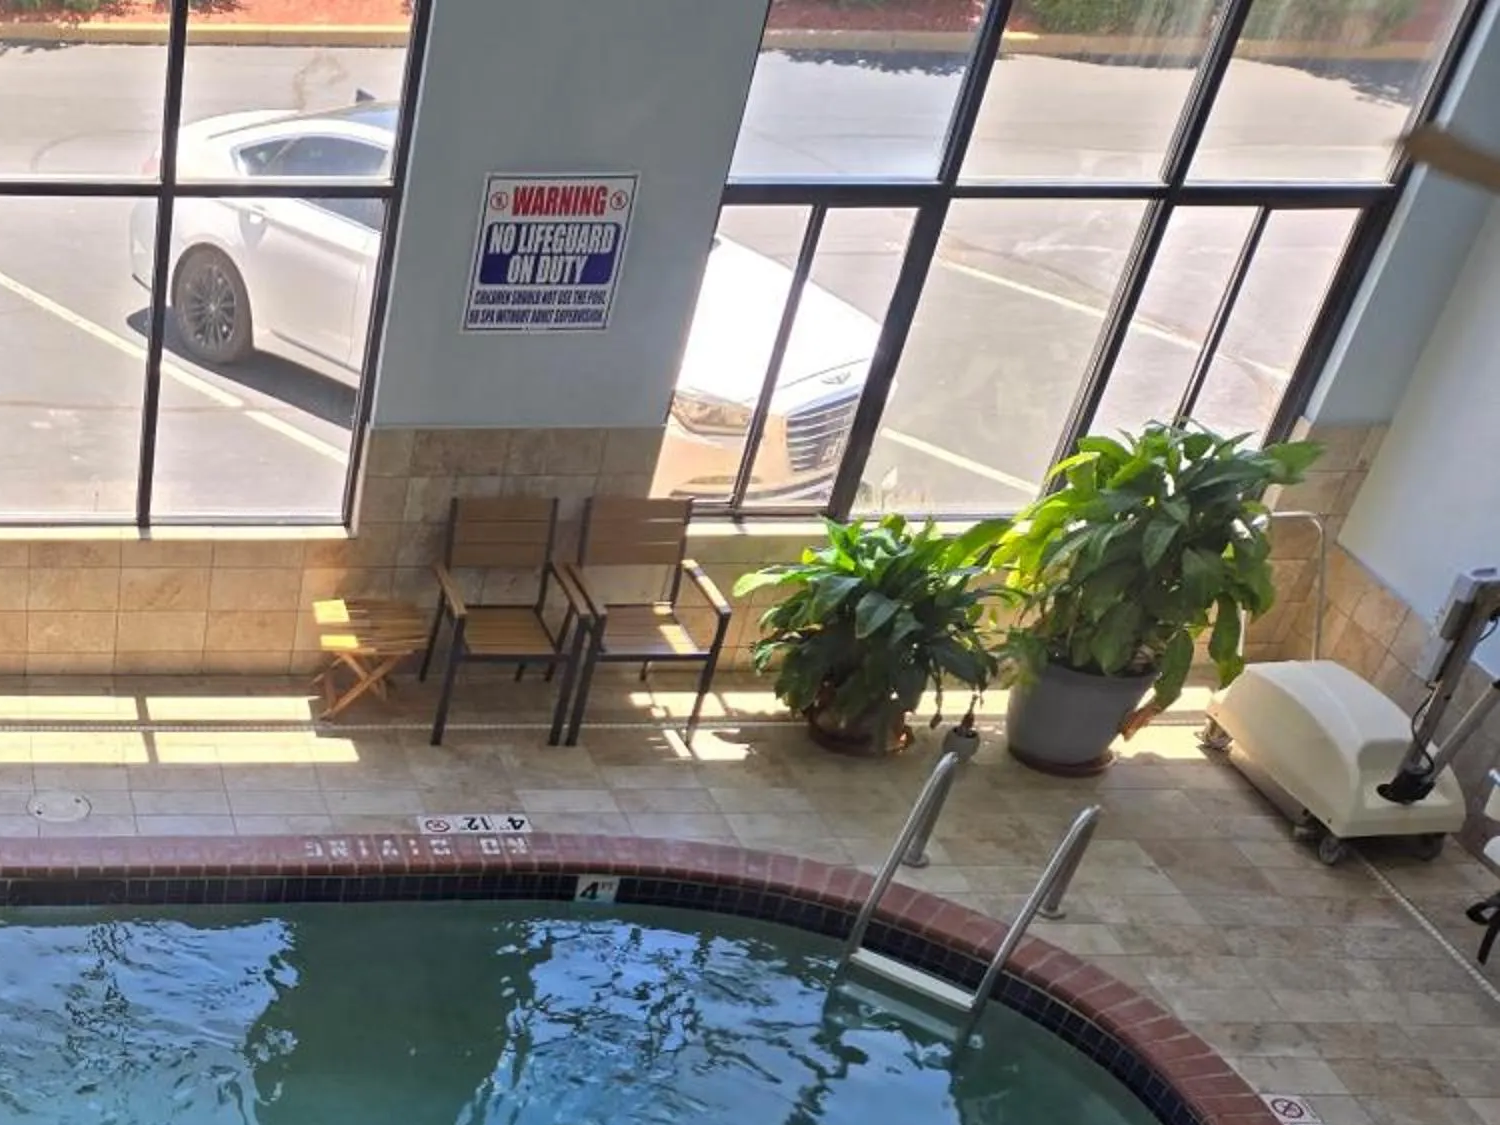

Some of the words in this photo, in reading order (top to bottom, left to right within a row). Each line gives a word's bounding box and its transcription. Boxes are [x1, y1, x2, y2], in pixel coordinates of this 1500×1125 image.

[511, 184, 608, 217] WARNING
[489, 224, 516, 254] NO
[517, 224, 616, 254] LIFEGUARD
[507, 255, 536, 283] ON
[536, 255, 589, 283] DUTY
